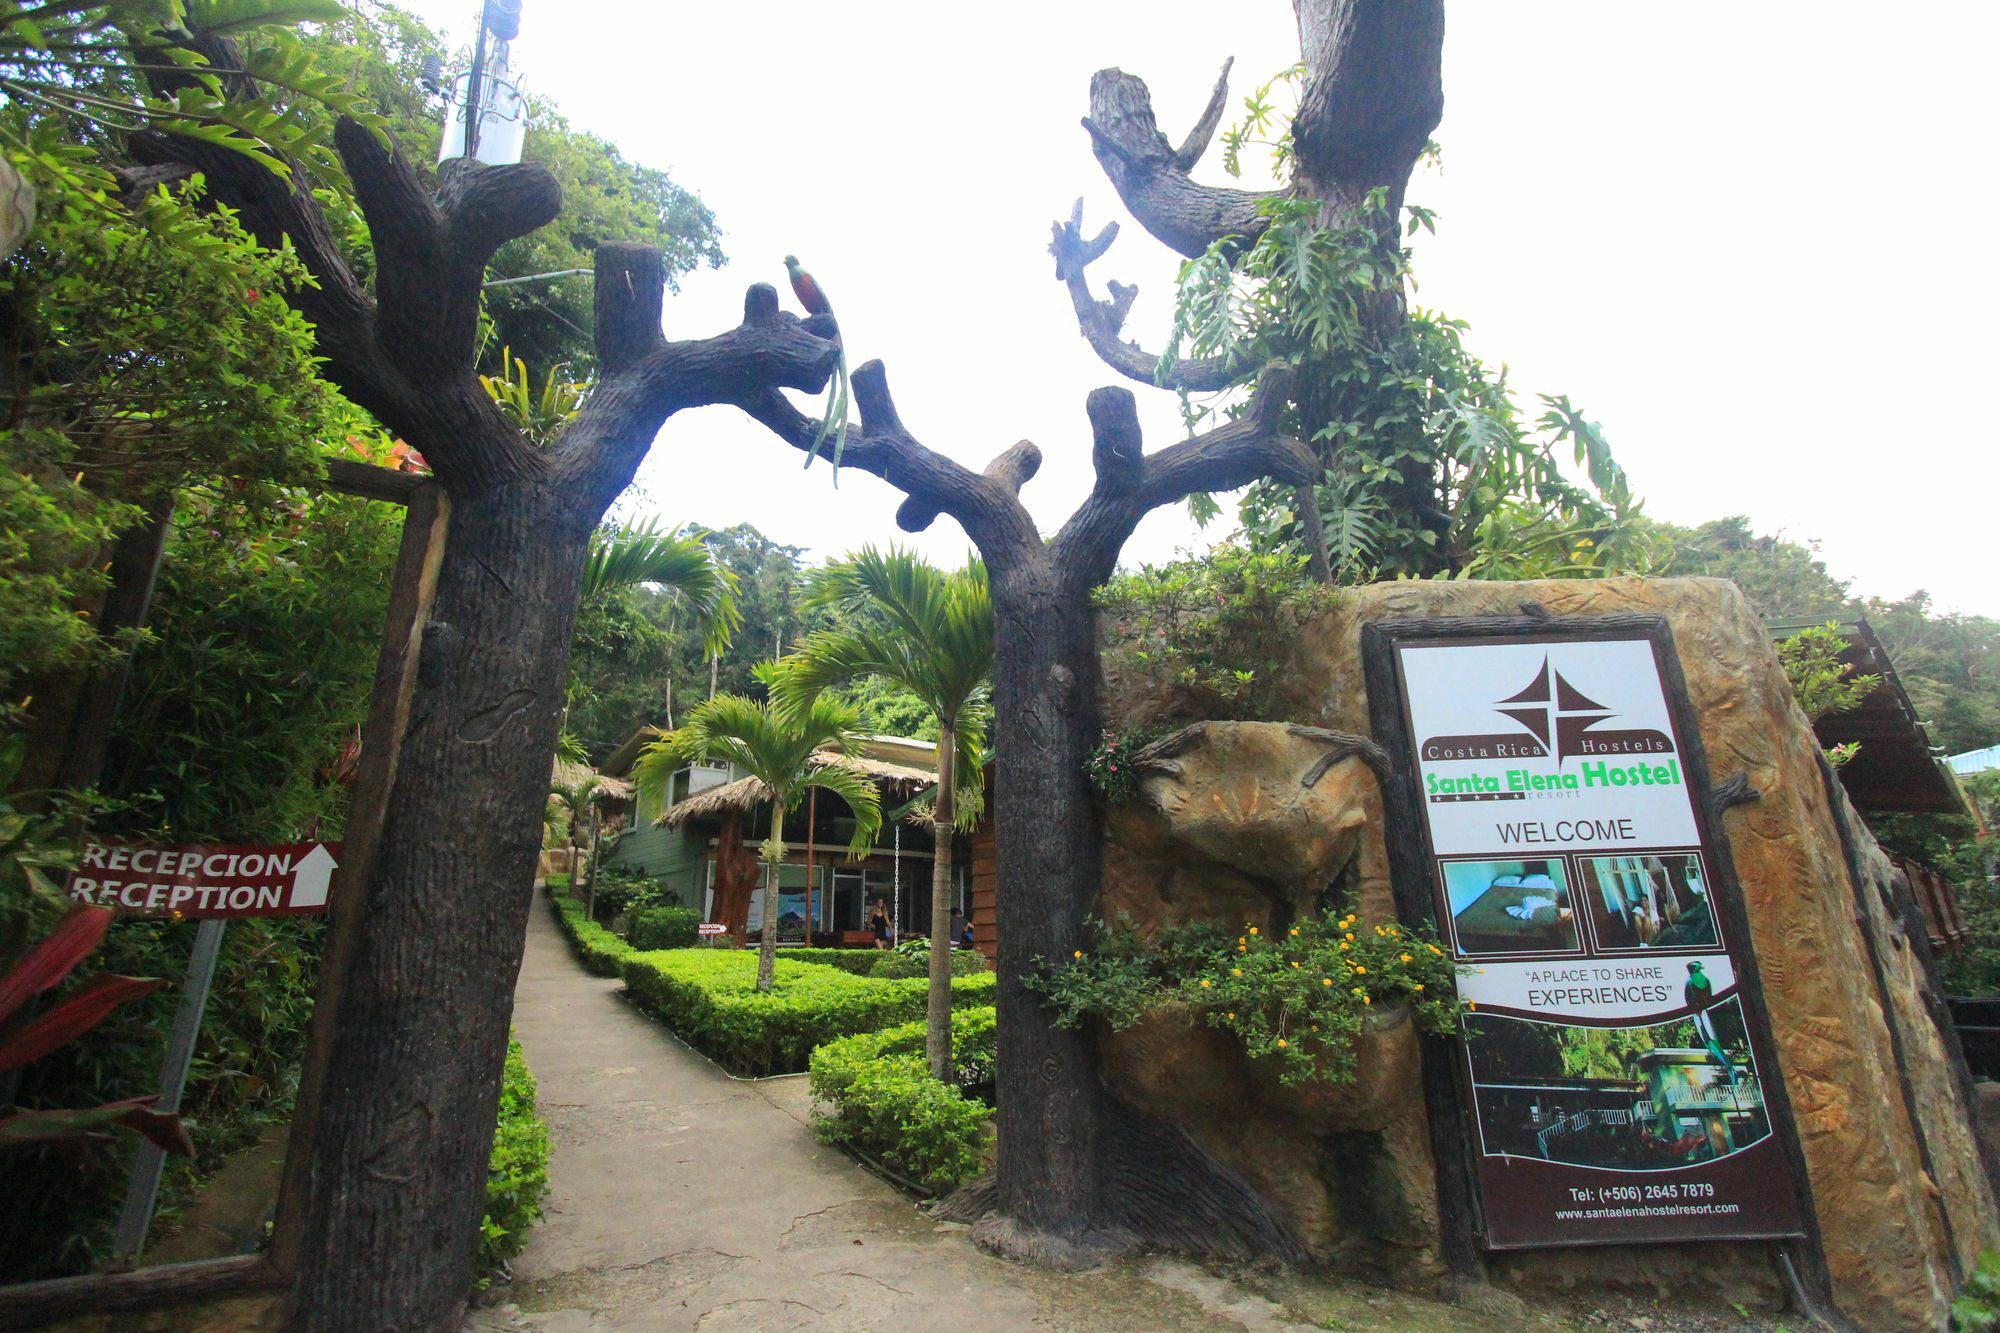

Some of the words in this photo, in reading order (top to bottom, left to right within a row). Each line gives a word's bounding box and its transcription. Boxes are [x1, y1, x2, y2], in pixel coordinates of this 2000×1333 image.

[1427, 746, 1488, 760] Costa
[1496, 743, 1542, 757] Rica
[1581, 738, 1664, 753] Hostels
[1426, 772, 1500, 795] Santa
[1506, 769, 1579, 792] Elena
[1581, 759, 1681, 788] Hostel
[1527, 789, 1581, 800] resort
[1496, 818, 1636, 844] WELCOME
[82, 843, 291, 877] RECEPCION
[70, 877, 283, 910] RECEPTION
[1543, 969, 1589, 983] PLACE
[1592, 968, 1611, 981] TO
[1615, 967, 1664, 981] SHARE
[1569, 1187, 1595, 1202] Tel:
[1598, 1185, 1642, 1204] (+506)
[1644, 1184, 1678, 1199] 2645
[1681, 1183, 1714, 1198] 7879
[1555, 1203, 1740, 1220] www.santaelenahostelresort.com
